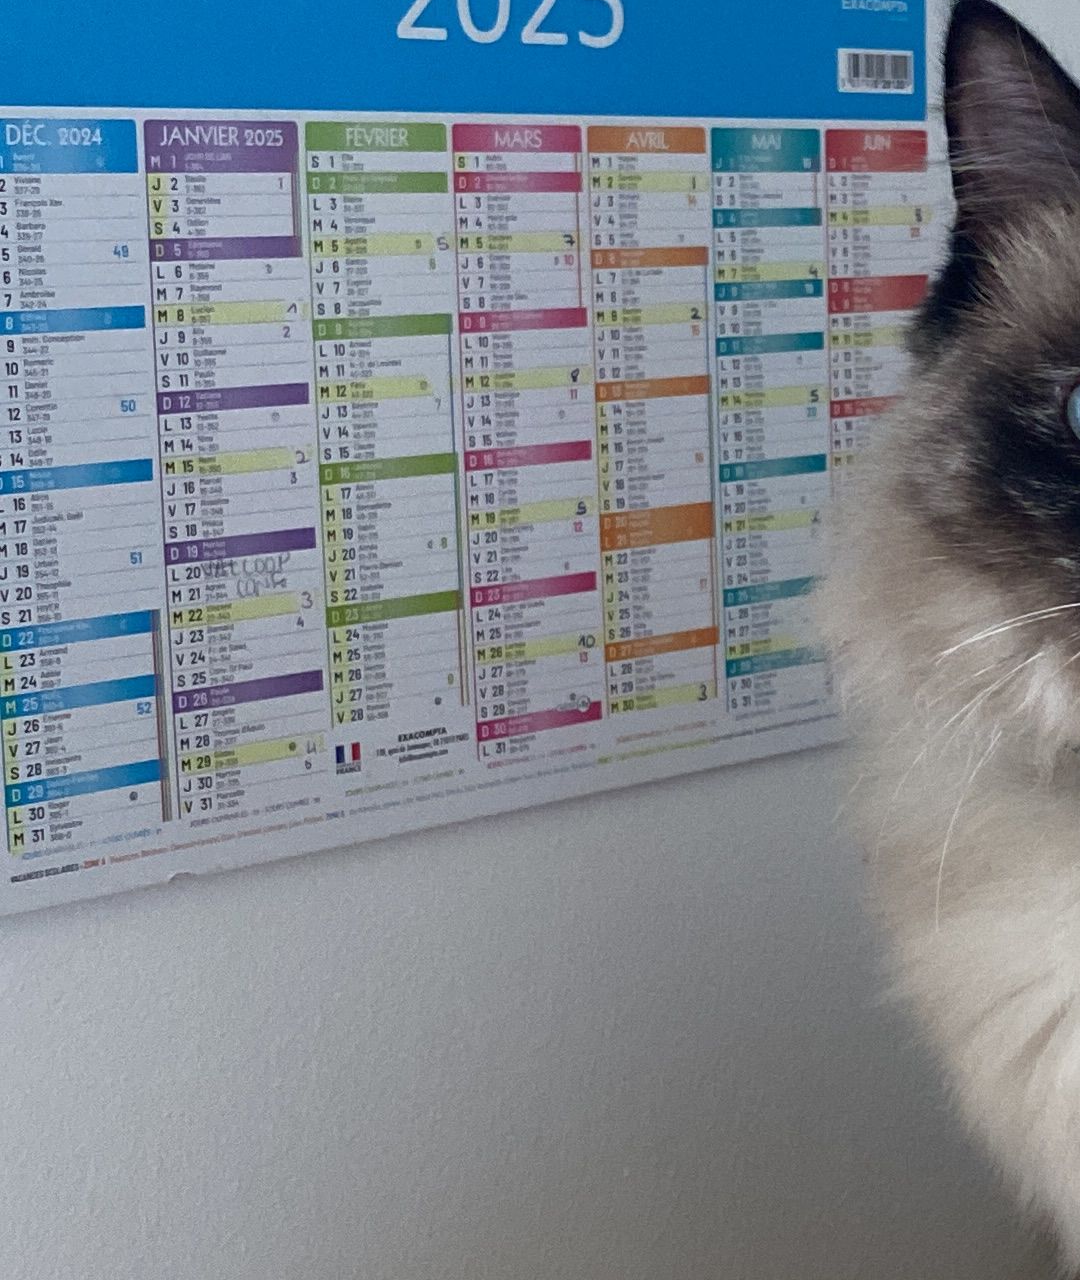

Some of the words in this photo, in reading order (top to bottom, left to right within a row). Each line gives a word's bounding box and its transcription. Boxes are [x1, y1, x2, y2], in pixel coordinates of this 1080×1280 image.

[6, 120, 50, 146] DÉC.
[57, 127, 102, 146] 2024
[159, 125, 240, 147] JANVIER
[244, 129, 284, 147] 2025
[345, 125, 409, 147] FÉVRIER
[494, 129, 543, 148] MARS
[625, 131, 670, 150] AVRIL
[751, 134, 782, 151] MAI
[863, 134, 892, 152] JUIN
[151, 156, 161, 169] M
[170, 155, 176, 169] 1
[311, 156, 319, 168] S
[329, 156, 335, 168] 1
[457, 156, 466, 168] S
[474, 156, 480, 168] 1
[152, 177, 161, 191] J
[171, 177, 178, 191] 2
[0, 202, 7, 216] 3
[153, 200, 162, 213] V
[172, 200, 179, 213] 3
[0, 225, 9, 239] 4
[154, 222, 163, 235] S
[172, 222, 180, 235] 4
[155, 244, 164, 257] D
[173, 244, 182, 257] 5
[314, 240, 324, 253] M
[331, 240, 339, 253] 5
[2, 248, 10, 262] 5
[563, 254, 574, 266] 10
[3, 271, 11, 285] 6
[157, 266, 165, 279] L
[175, 266, 183, 279] 6
[316, 282, 325, 295] V
[333, 282, 340, 294] 7
[462, 277, 470, 289] V
[477, 276, 484, 288] 7
[4, 293, 12, 308] 7
[157, 288, 167, 301] M
[175, 287, 184, 300] 7
[5, 316, 14, 330] 8
[158, 309, 168, 323] M
[176, 309, 185, 322] 8
[159, 332, 168, 345] J
[178, 331, 186, 344] 9
[6, 339, 15, 353] 9
[160, 353, 169, 366] V
[176, 352, 189, 366] 10
[5, 362, 19, 376] 10
[8, 385, 18, 399] 11
[320, 386, 330, 398] M
[336, 385, 347, 398] 12
[120, 399, 136, 412] 50
[163, 397, 172, 411] D
[178, 395, 191, 409] 12
[7, 407, 21, 421] 12
[8, 430, 22, 444] 13
[10, 453, 24, 466] 14
[165, 461, 176, 474] M
[182, 460, 194, 474] 15
[11, 476, 24, 489] 15
[470, 475, 477, 487] L
[484, 473, 494, 486] 17
[13, 497, 26, 511] 16
[168, 504, 177, 517] V
[184, 503, 196, 516] 17
[14, 520, 27, 534] 17
[473, 532, 480, 545] J
[484, 531, 498, 544] 20
[15, 542, 28, 555] 18
[129, 551, 143, 565] 51
[604, 554, 614, 566] M
[616, 553, 628, 565] 22
[736, 555, 748, 567] 23
[16, 564, 29, 578] 19
[0, 589, 9, 602] V
[15, 586, 32, 601] 20
[301, 591, 313, 609] 3
[331, 590, 339, 603] S
[344, 588, 358, 601] 22
[607, 591, 614, 603] J
[618, 588, 630, 602] 24
[1, 611, 10, 625] S
[19, 609, 32, 623] 21
[2, 634, 12, 647] D
[18, 631, 34, 646] 22
[3, 657, 13, 669] L
[20, 653, 36, 668] 23
[175, 653, 185, 666] V
[190, 651, 206, 664] 24
[4, 678, 15, 692] M
[20, 676, 37, 690] 24
[5, 700, 16, 714] M
[22, 698, 38, 712] 25
[136, 702, 151, 715] 52
[7, 723, 17, 736] J
[23, 719, 40, 734] 26
[397, 726, 448, 743] EXACOMPTA
[8, 745, 18, 758] V
[25, 741, 41, 756] 27
[483, 744, 490, 757] L
[495, 741, 506, 754] 31
[10, 767, 20, 780] S
[26, 763, 42, 778] 28
[11, 789, 21, 802] D
[27, 785, 44, 799] 29
[183, 800, 193, 813] V
[200, 797, 213, 811] 31
[13, 810, 23, 824] L
[28, 806, 45, 821] 30
[13, 832, 24, 846] M
[31, 829, 45, 843] 31
